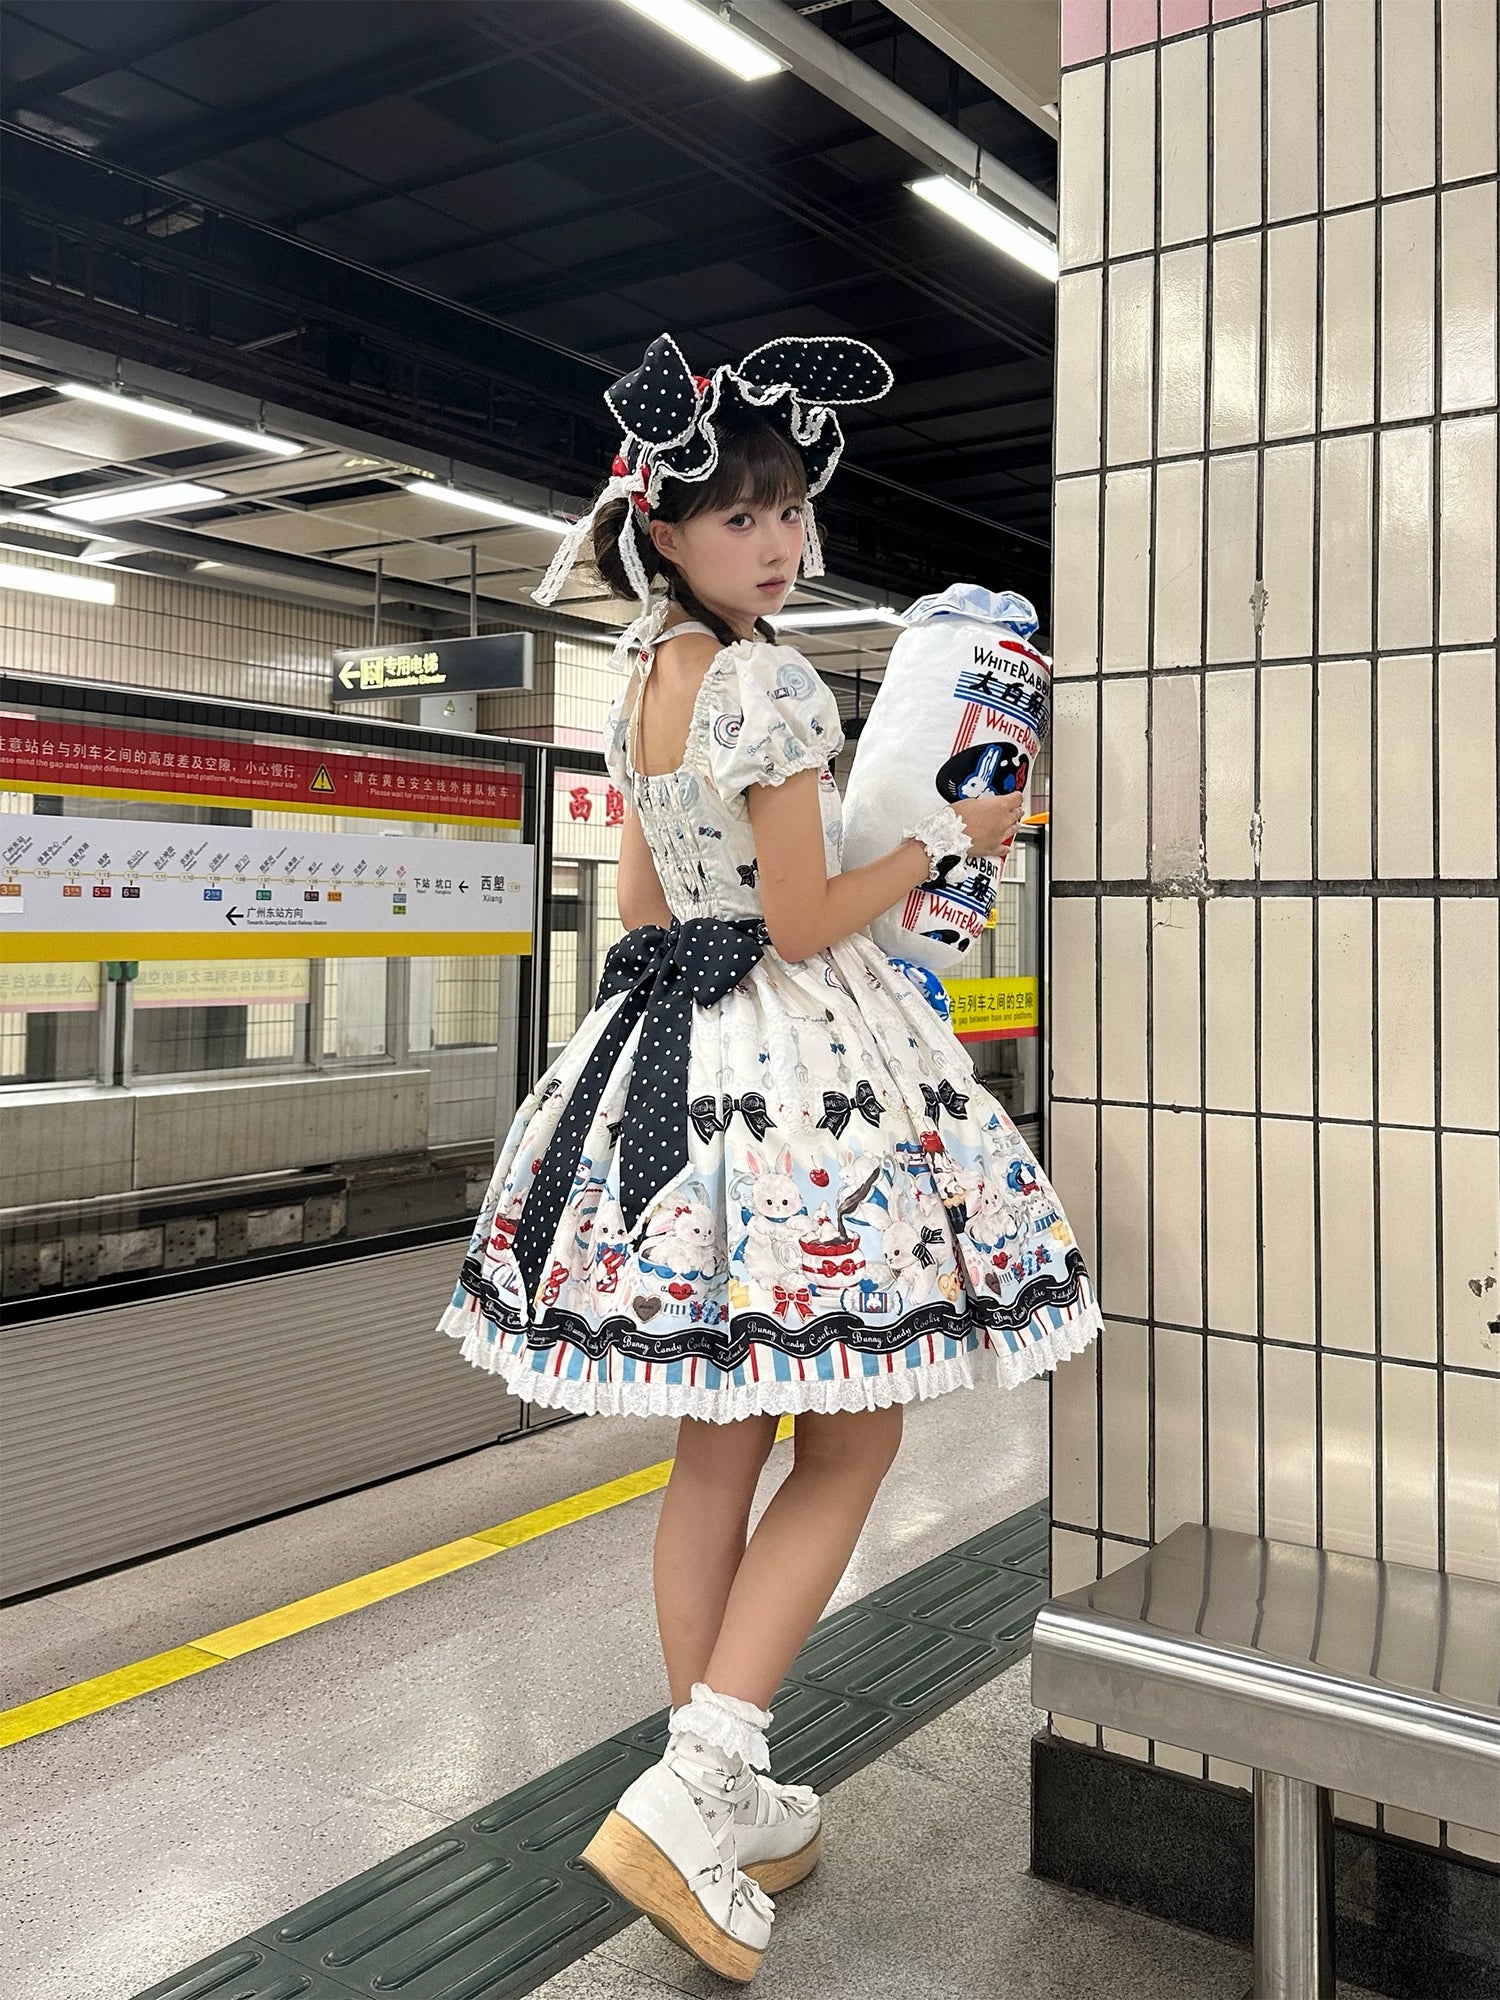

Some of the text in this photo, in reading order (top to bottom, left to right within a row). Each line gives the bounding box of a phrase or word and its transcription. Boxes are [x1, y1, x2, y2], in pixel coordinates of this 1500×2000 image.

[384, 652, 439, 676] 专用电梯
[16, 758, 35, 766] mind
[36, 759, 49, 767] the
[49, 761, 64, 769] gap
[80, 764, 103, 773] height
[104, 765, 140, 775] difference
[140, 768, 169, 777] between
[229, 776, 251, 784] Please
[413, 878, 430, 888] 下站
[435, 878, 452, 889] 坑口
[481, 875, 505, 892] 西塱
[482, 894, 503, 904] Xilang
[246, 907, 303, 919] 广州东站方向
[958, 1017, 968, 1026] gap
[747, 1320, 839, 1352] Bunny Candy Cookie
[852, 1331, 882, 1348] Bunny
[887, 1327, 911, 1344] Candy
[913, 1313, 940, 1331] Cookie
[622, 1335, 650, 1355] Bunny
[654, 1341, 682, 1354] Candy
